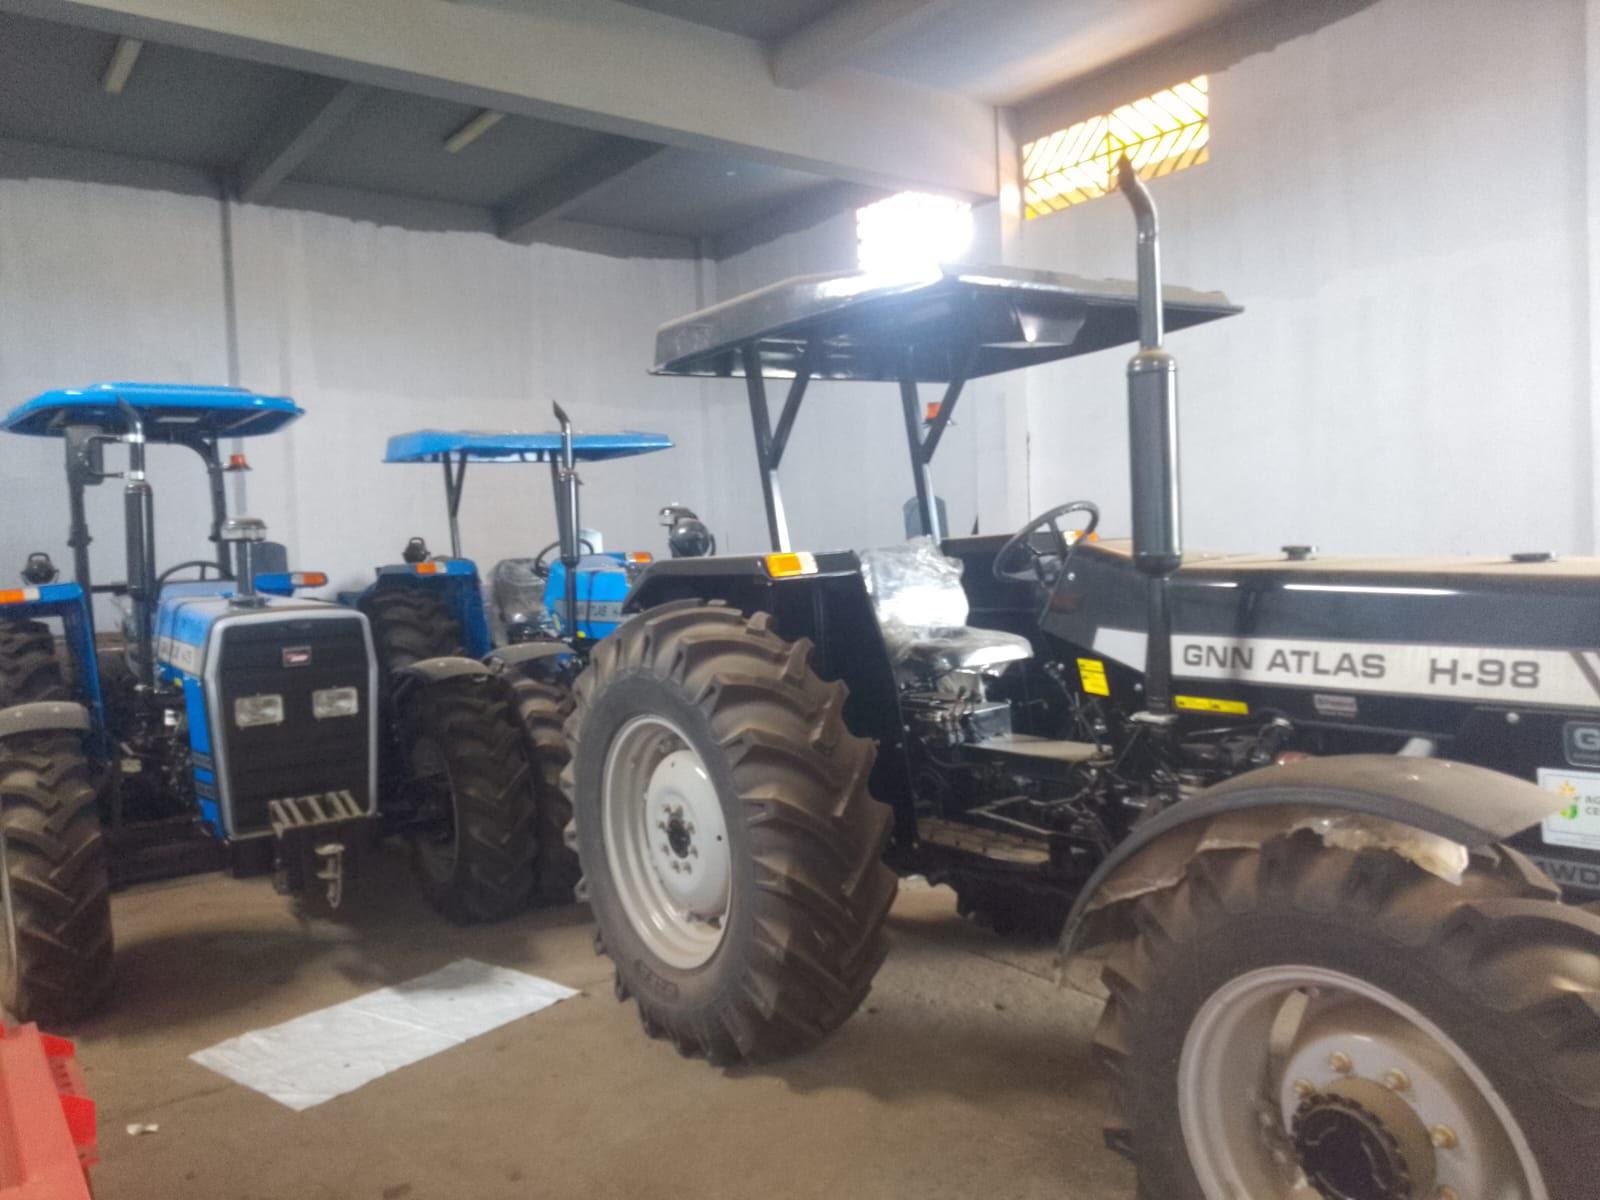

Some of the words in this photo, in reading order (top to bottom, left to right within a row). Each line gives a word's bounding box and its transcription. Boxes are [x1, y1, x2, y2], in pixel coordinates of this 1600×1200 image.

[1183, 644, 1254, 670] GNN
[1266, 649, 1386, 679] ATLAS
[1428, 658, 1541, 689] H-98
